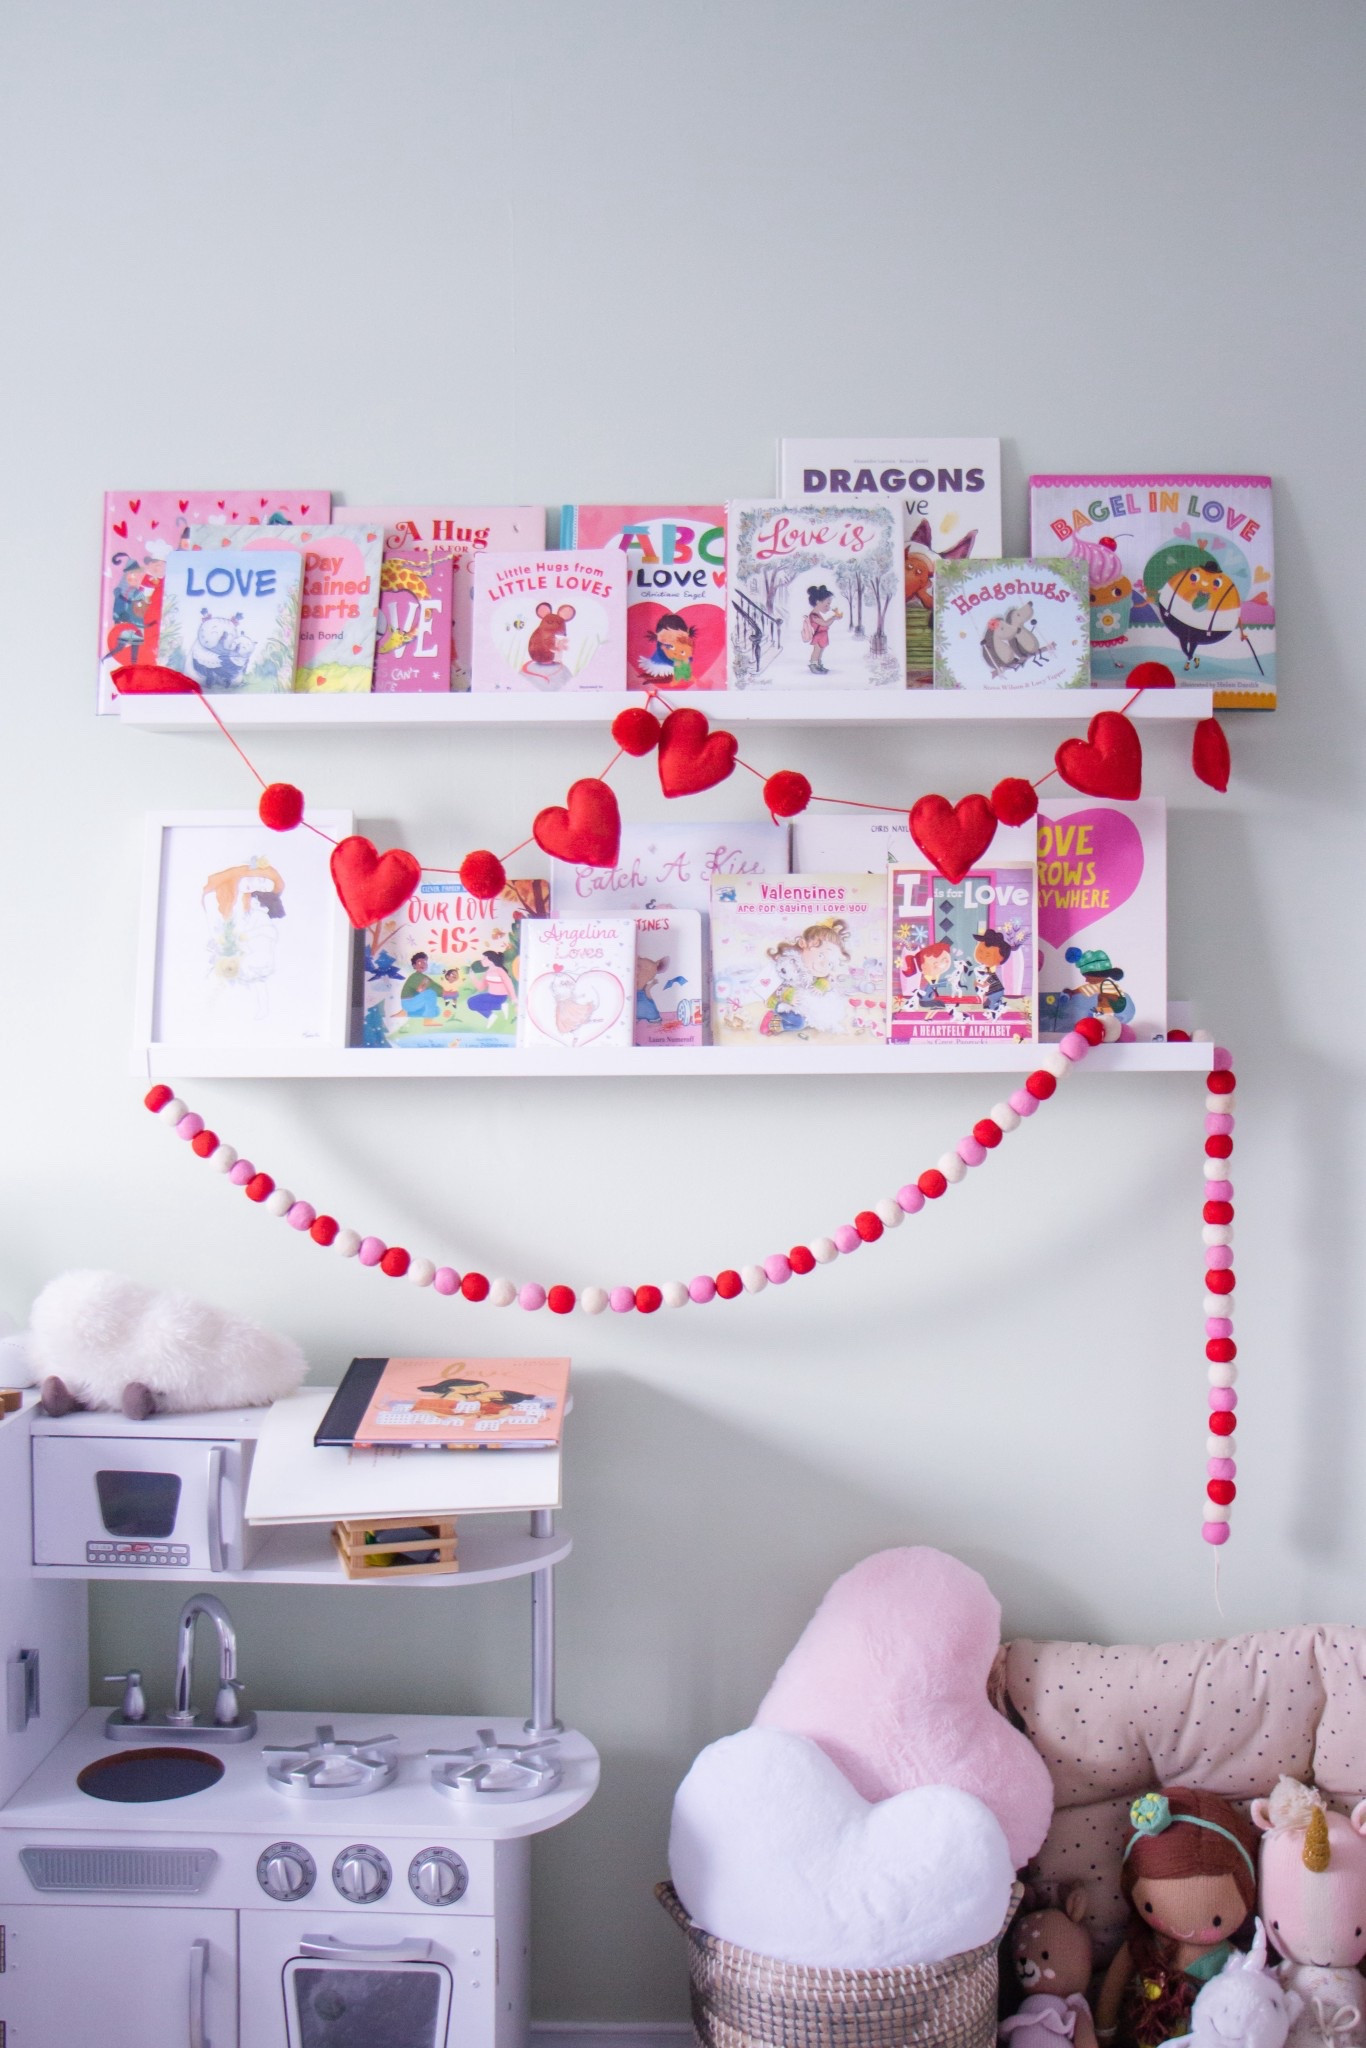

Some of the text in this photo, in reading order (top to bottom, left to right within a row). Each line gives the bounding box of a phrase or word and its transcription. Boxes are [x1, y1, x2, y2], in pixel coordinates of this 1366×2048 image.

[803, 468, 985, 493] DRAGONS
[905, 500, 929, 515] ve
[1050, 491, 1261, 542] BAGEL IN LOVE
[386, 520, 490, 549] A Hug
[618, 524, 725, 566] ABC
[756, 518, 875, 560] Love is
[305, 552, 344, 576] Day
[496, 562, 604, 581] Little Hugs from
[186, 567, 277, 598] LOVE
[488, 576, 612, 601] LITTLE LOVES
[637, 568, 707, 588] Love
[301, 599, 360, 619] earts
[951, 578, 1071, 615] Hedgehugs
[300, 631, 344, 640] cia Bond
[388, 599, 442, 658] VE
[392, 667, 420, 680] CAN'T
[1037, 825, 1094, 858] OVE
[575, 858, 648, 898] Catch
[656, 851, 691, 882] A
[1037, 861, 1096, 886] ROWS
[761, 884, 845, 900] Valentines
[896, 874, 1030, 918] L is for Love
[1038, 888, 1110, 909] YWHERE
[408, 896, 499, 923] OUR LOVE
[738, 904, 755, 912] Are
[759, 904, 775, 912] for
[780, 903, 813, 913] saying
[539, 923, 618, 947] Angelina
[634, 918, 670, 931] TINE'S
[441, 926, 468, 953] IS
[555, 943, 604, 959] Loves
[912, 1025, 1011, 1037] A HEARTFELT ALPHABET
